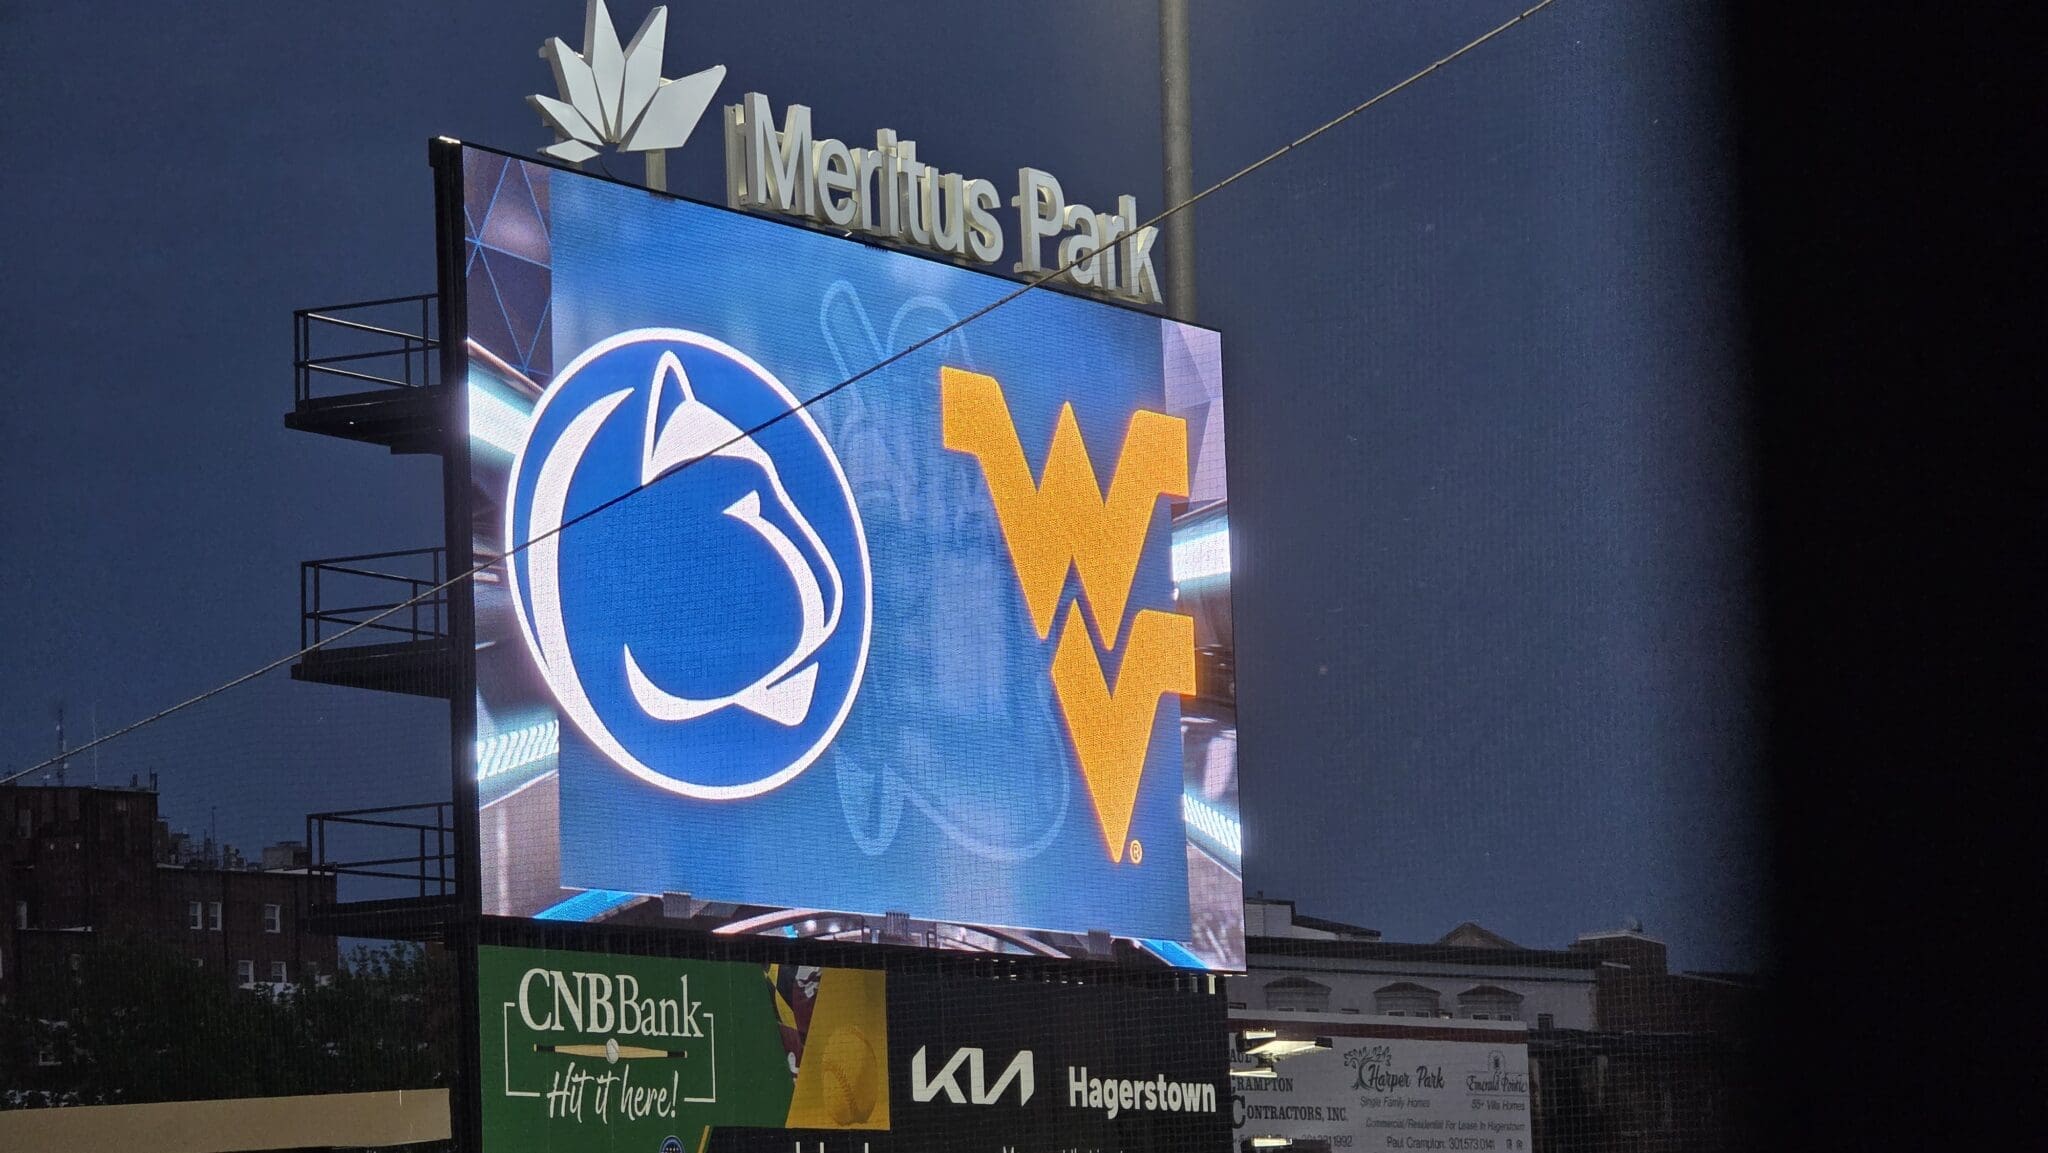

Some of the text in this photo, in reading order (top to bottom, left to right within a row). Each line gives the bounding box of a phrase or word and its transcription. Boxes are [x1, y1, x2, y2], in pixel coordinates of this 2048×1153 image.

[740, 91, 1164, 304] Meritus Park
[546, 1061, 680, 1125] Hit it here!
[911, 1044, 1217, 1120] KIA Hagerstown
[1367, 1064, 1445, 1093] Harper Park
[1502, 1100, 1526, 1111] Homes
[1458, 1120, 1479, 1131] Lease
[1386, 1135, 1405, 1149] Paul
